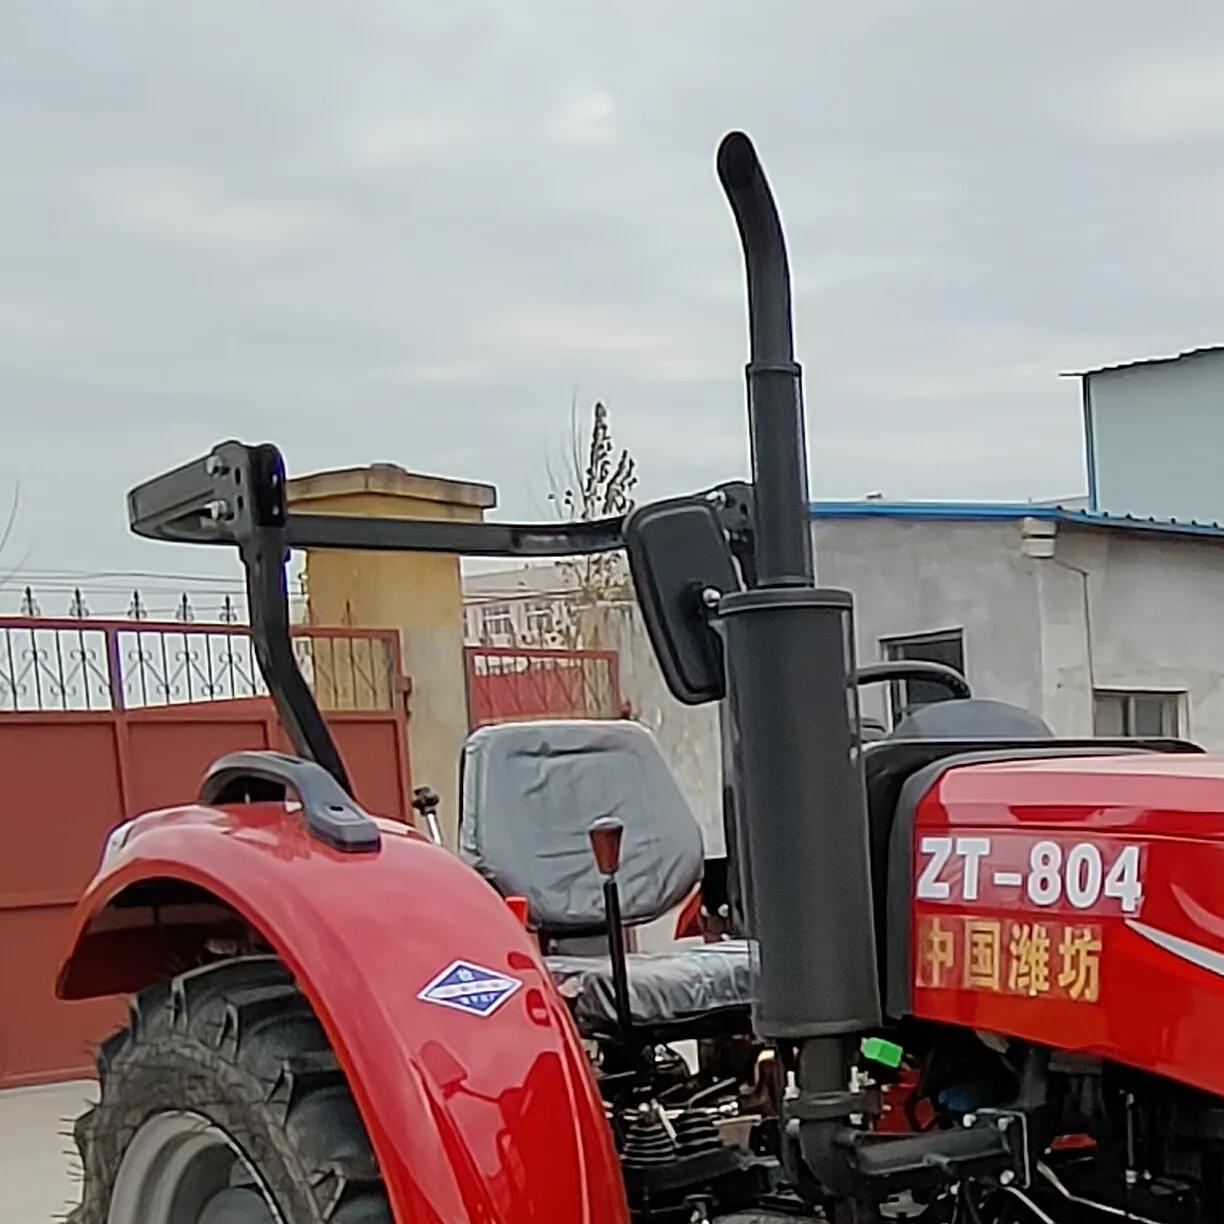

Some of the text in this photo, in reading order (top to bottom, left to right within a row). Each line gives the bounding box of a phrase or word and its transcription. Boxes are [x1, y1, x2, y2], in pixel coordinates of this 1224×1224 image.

[917, 837, 1142, 912] ZT-804
[920, 917, 1102, 1002] 中国潍坊
